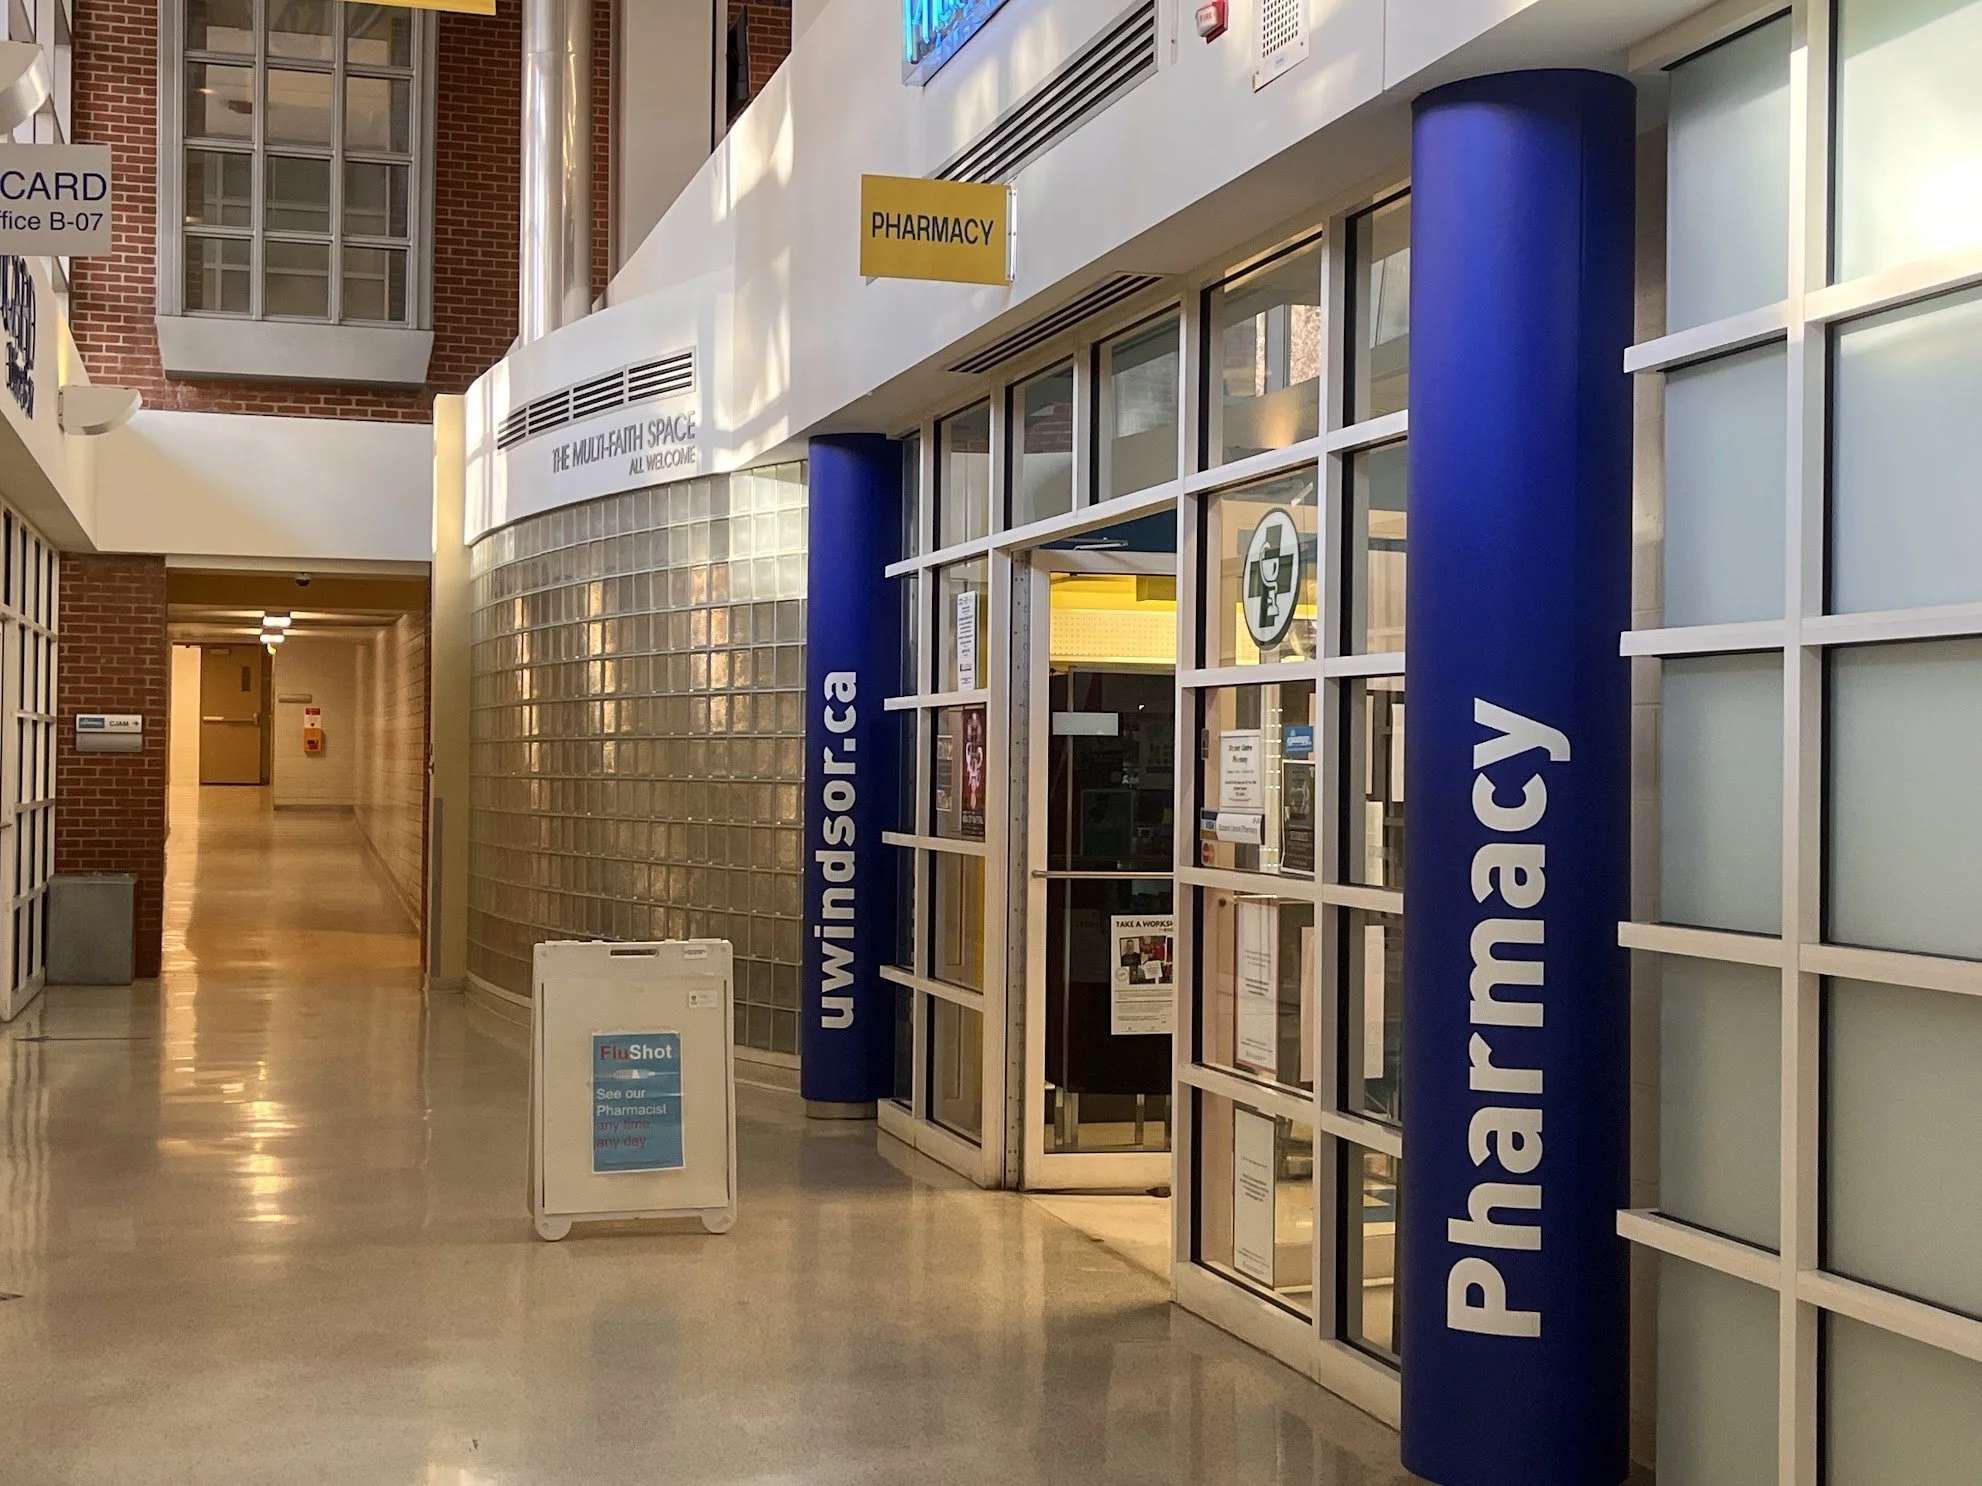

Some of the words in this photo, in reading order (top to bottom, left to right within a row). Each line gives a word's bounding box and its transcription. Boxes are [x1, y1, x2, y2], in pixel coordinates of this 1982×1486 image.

[0, 171, 107, 200] CARD
[50, 211, 103, 231] B-07
[871, 211, 994, 246] PHARMACY
[552, 444, 570, 473] THE
[572, 423, 643, 467] MULTI-FAITH
[647, 411, 696, 448] SPACE
[629, 456, 644, 476] ALL
[646, 445, 695, 472] WELCOME
[814, 671, 857, 1029] uwindsor.ca
[1116, 920, 1135, 928] TAKE
[1136, 920, 1142, 928] A
[1446, 696, 1571, 1338] Pharmacy
[601, 1044, 672, 1060] FluShot
[597, 1088, 621, 1100] See
[625, 1089, 646, 1099] our
[597, 1104, 667, 1117] Pharmacist
[599, 1121, 620, 1132] any
[596, 1137, 620, 1148] any
[623, 1135, 647, 1149] day
